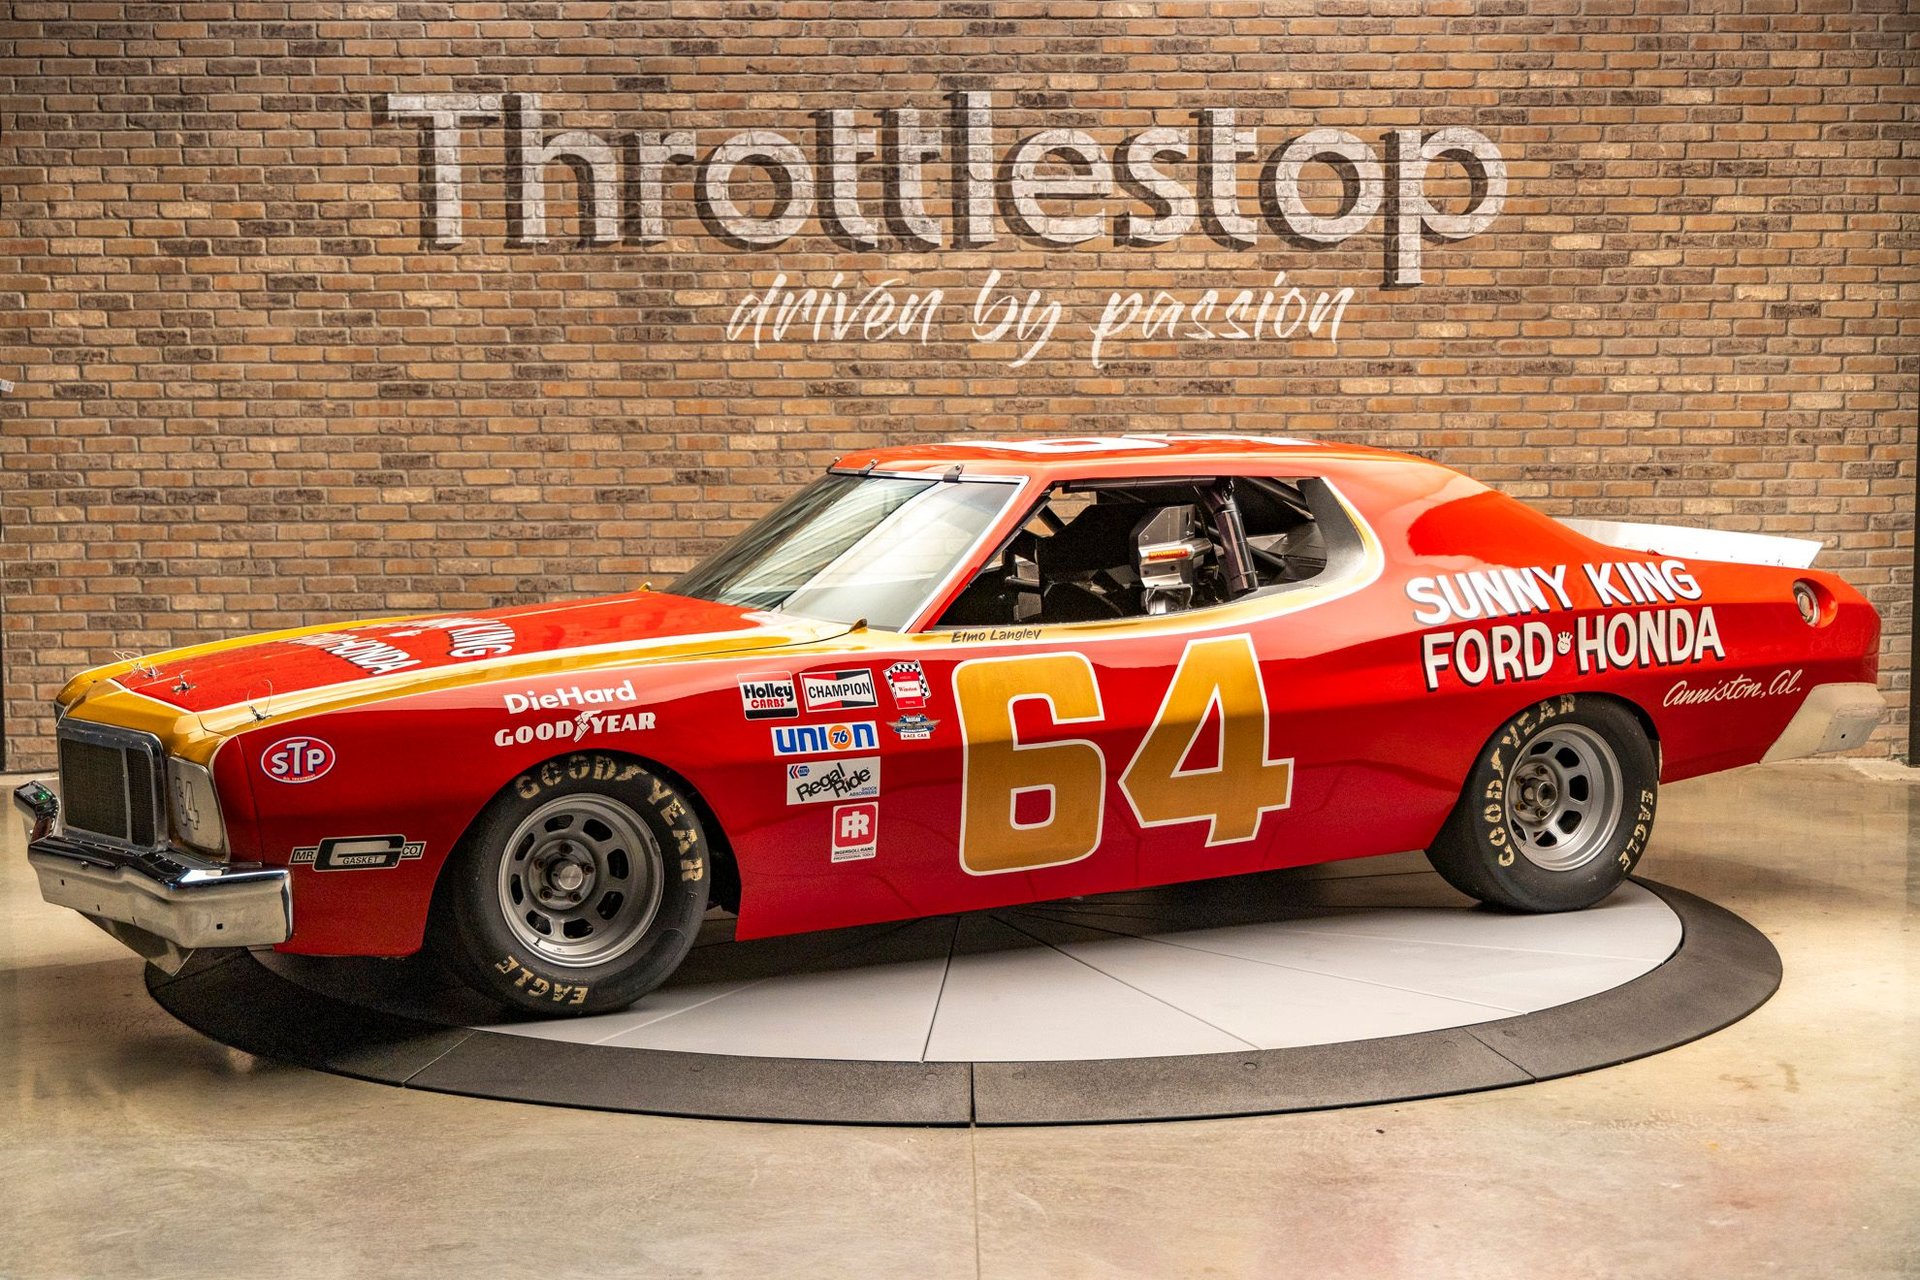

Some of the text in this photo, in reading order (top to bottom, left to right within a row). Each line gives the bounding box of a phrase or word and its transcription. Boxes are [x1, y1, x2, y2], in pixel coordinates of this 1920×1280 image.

[384, 90, 1508, 288] Throttlestop
[726, 269, 1355, 369] driven by passion
[1405, 559, 1703, 627] SUNNY KING
[951, 628, 1042, 643] Elmo Langley
[1421, 606, 1727, 691] FORD HONDA
[503, 679, 638, 715] DieHard
[742, 682, 795, 703] Holley
[750, 698, 785, 709] CARBS
[808, 682, 872, 699] CHAMPION
[832, 730, 849, 744] 76
[952, 632, 1295, 877] 64
[270, 741, 325, 775] STP
[795, 762, 846, 802] Regal
[833, 767, 872, 798] Ride
[1618, 789, 1654, 872] EAGLE
[295, 846, 419, 865] MR. GASKET CO.
[494, 955, 590, 1005] EAGLE
